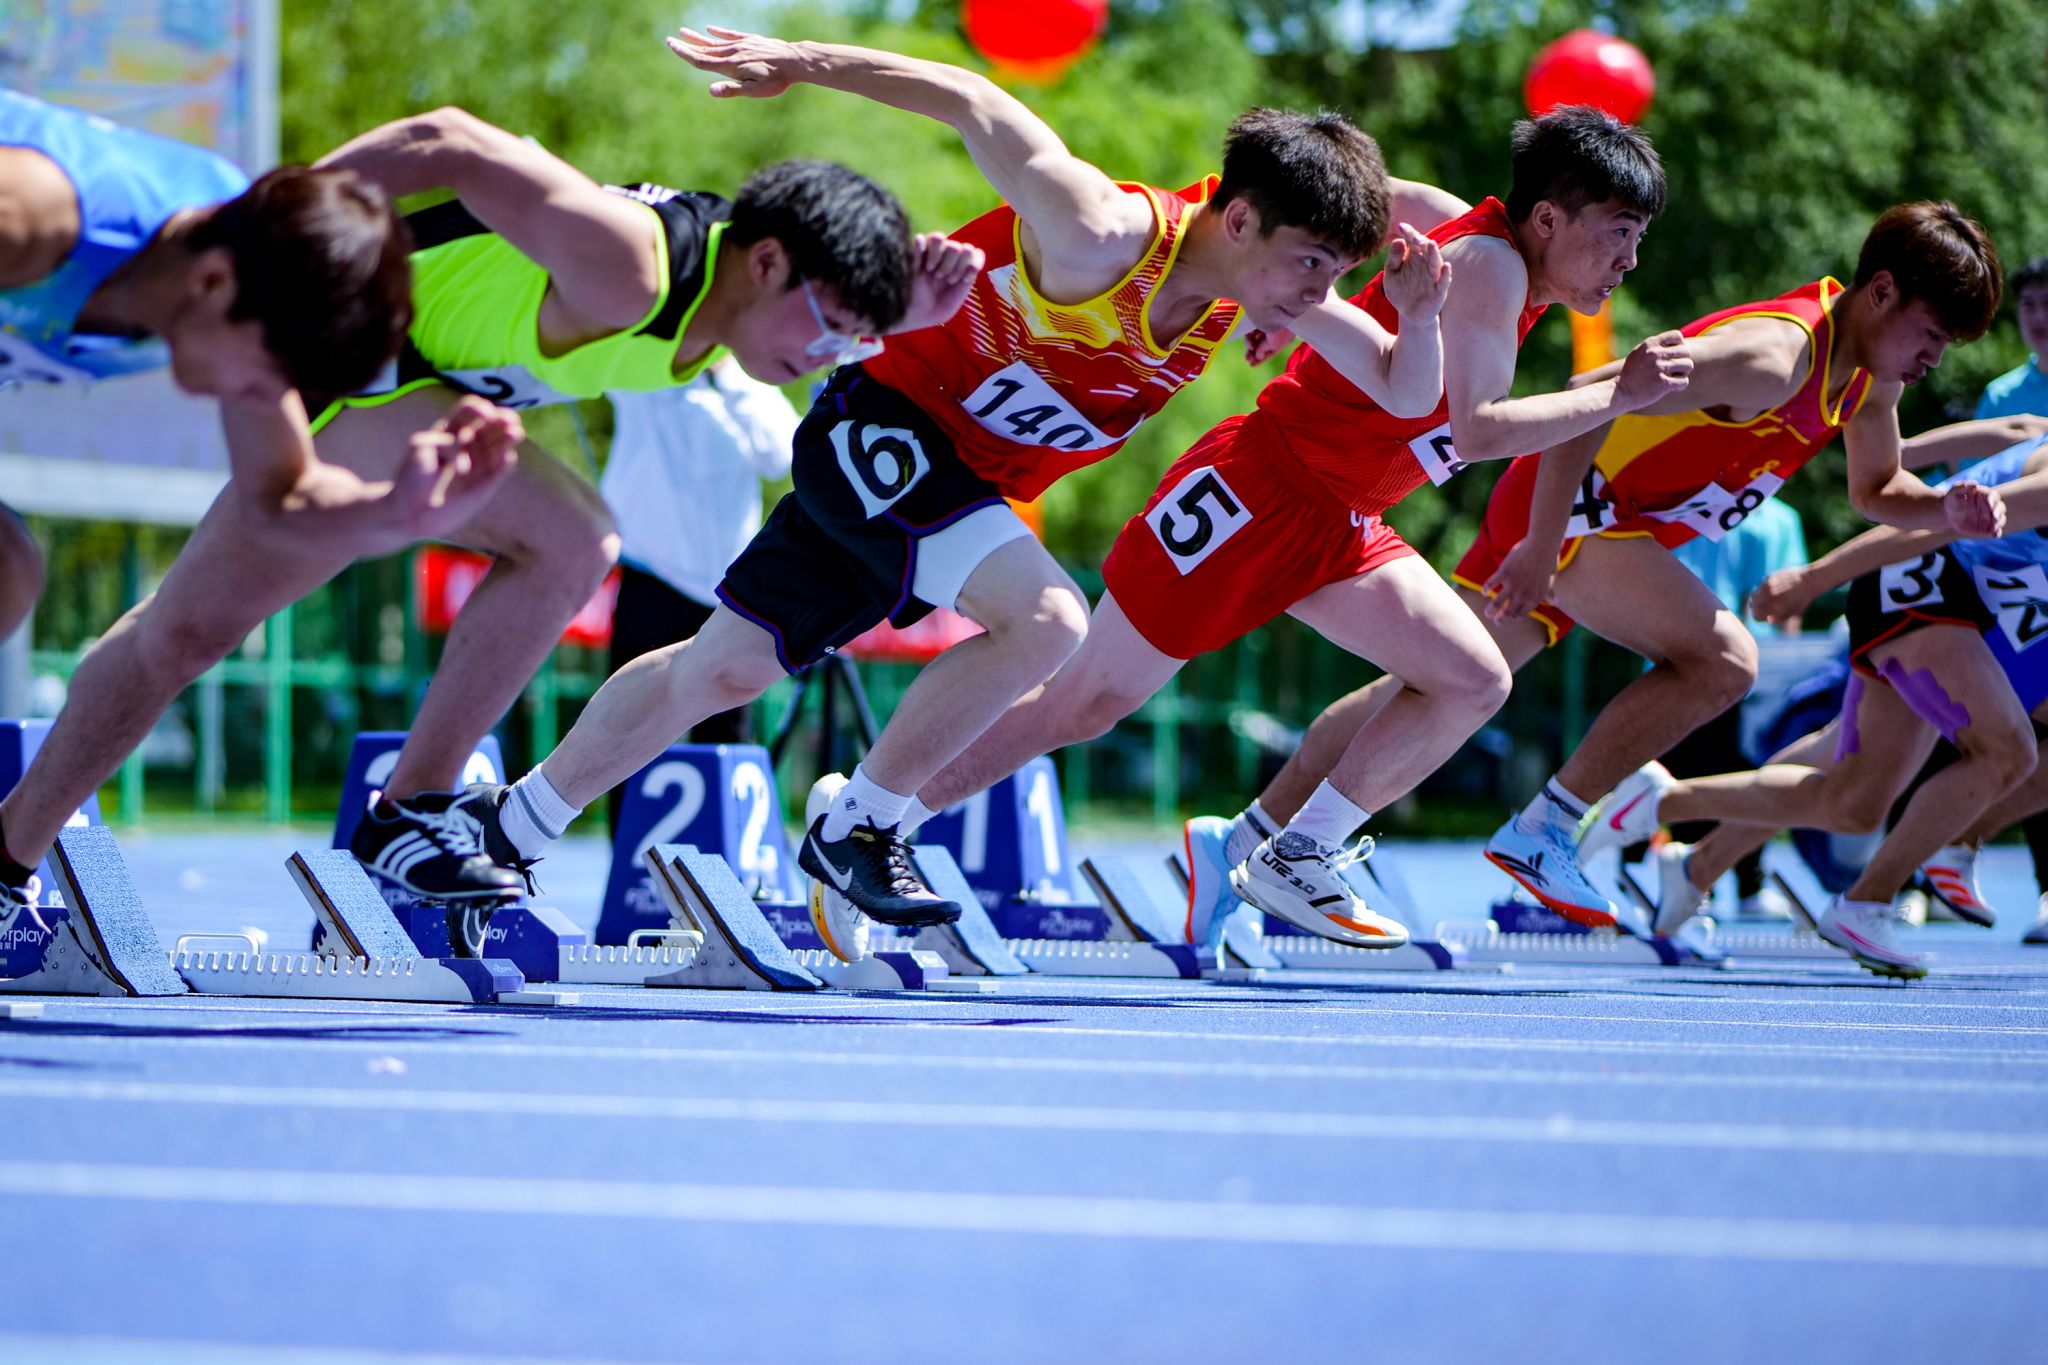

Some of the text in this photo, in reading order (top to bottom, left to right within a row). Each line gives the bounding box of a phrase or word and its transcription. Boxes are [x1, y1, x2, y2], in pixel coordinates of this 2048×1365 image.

[973, 378, 1094, 449] 140
[848, 420, 917, 501] 6
[1160, 472, 1240, 557] 5
[1888, 552, 1936, 604] 3
[631, 761, 706, 869] 2
[731, 761, 778, 872] 2
[1027, 770, 1061, 875] 1
[1289, 876, 1317, 896] 3.0
[3, 927, 45, 950] rplay
